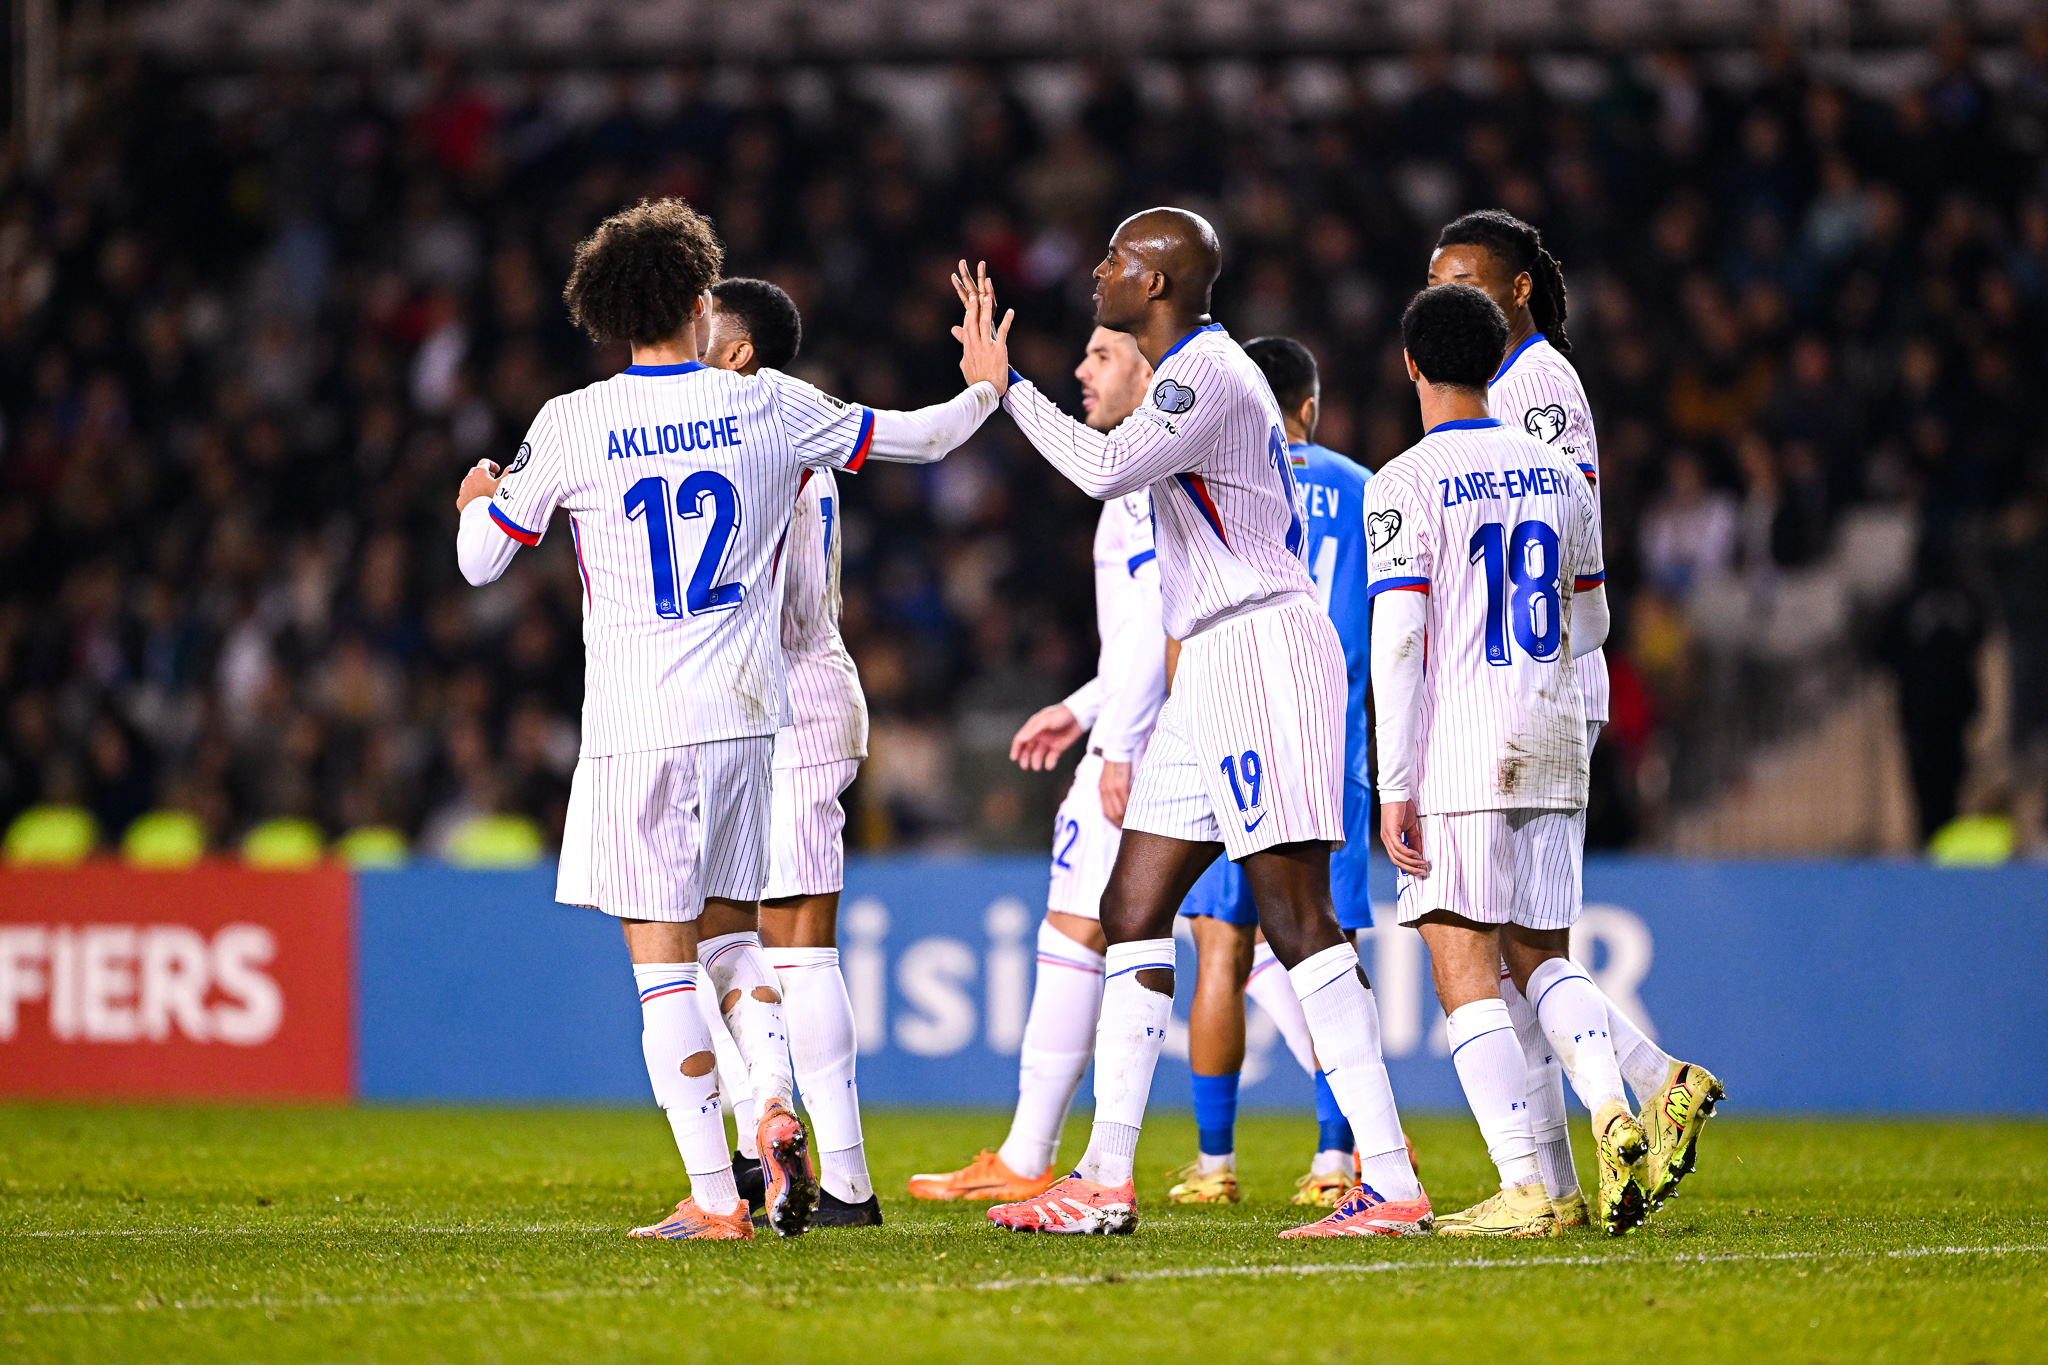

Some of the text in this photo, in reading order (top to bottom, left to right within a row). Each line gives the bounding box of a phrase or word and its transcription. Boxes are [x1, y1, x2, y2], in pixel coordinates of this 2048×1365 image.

[606, 415, 742, 461] AKLIOUCHE
[1438, 466, 1572, 508] ZAIRE-EMERY
[622, 470, 747, 620] 12
[1392, 557, 1407, 567] 10
[1469, 519, 1561, 666] 18
[1220, 749, 1262, 812] 19
[0, 924, 282, 1046] FIERS
